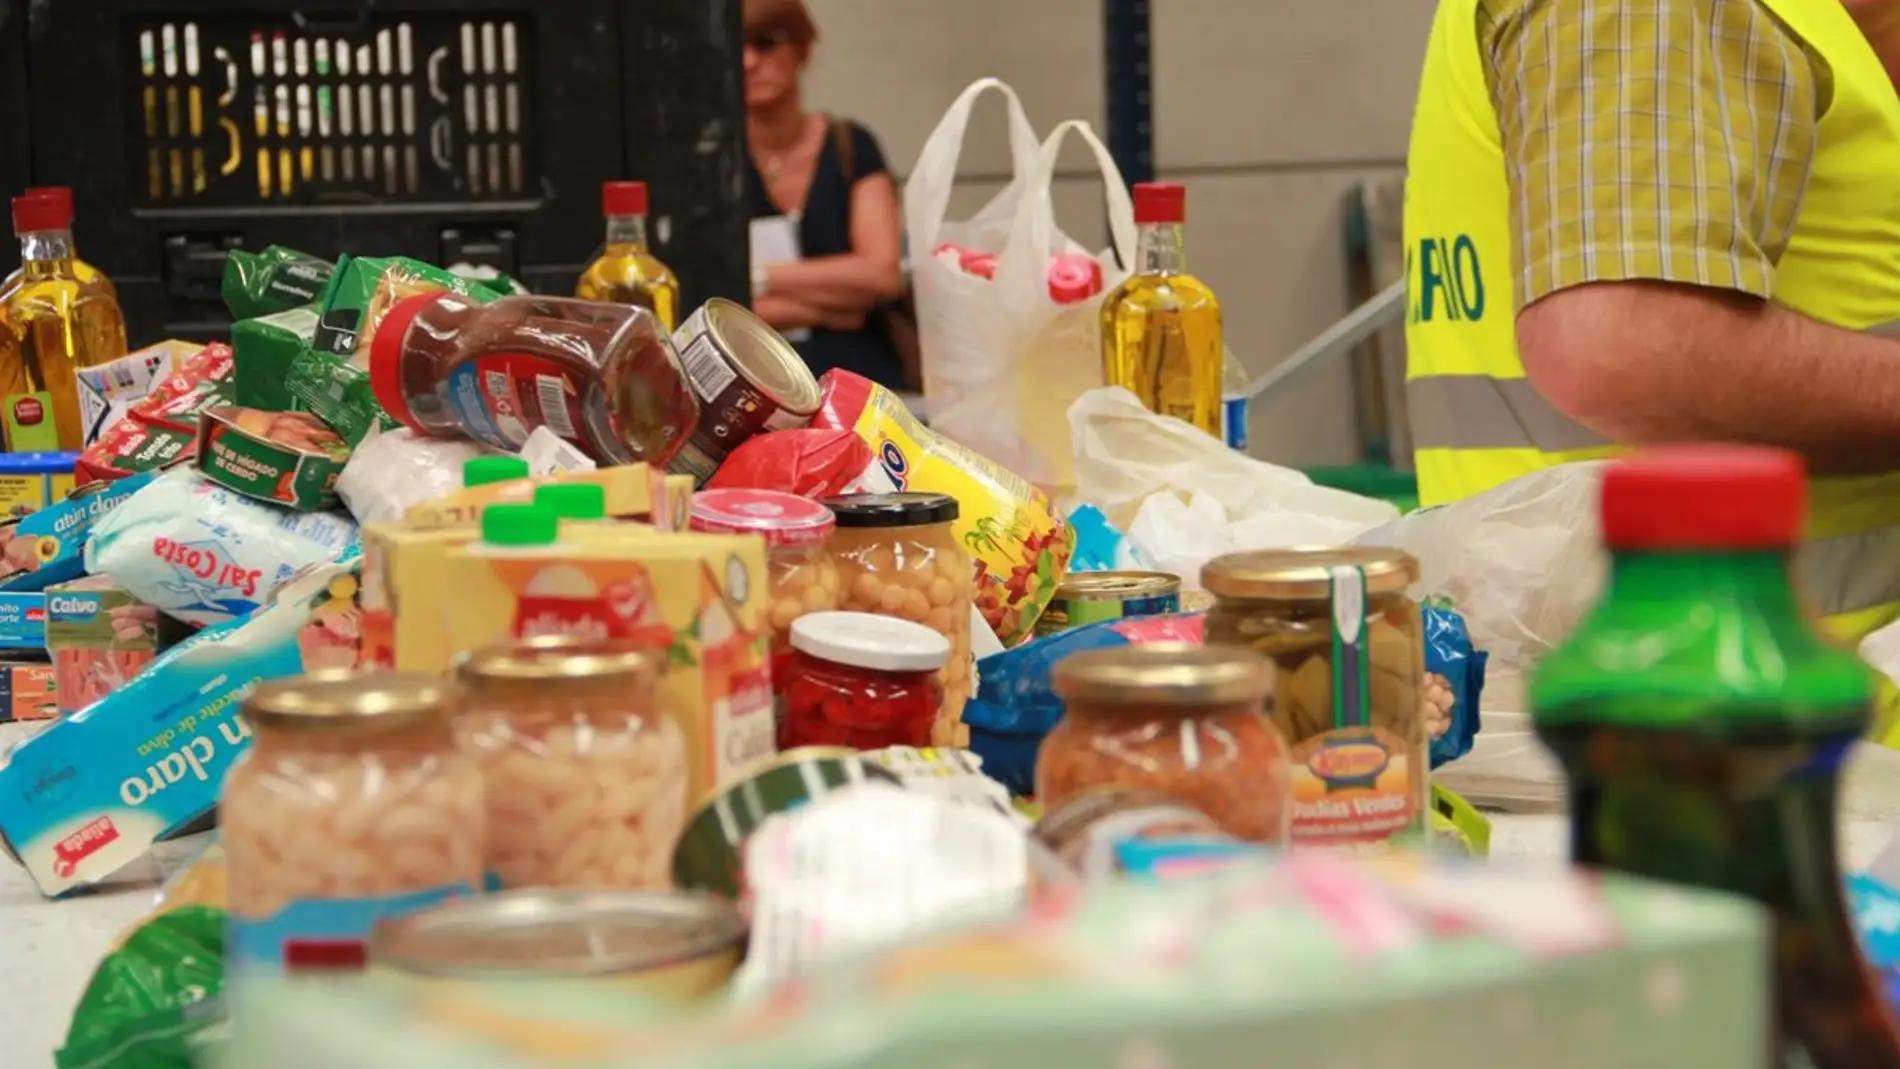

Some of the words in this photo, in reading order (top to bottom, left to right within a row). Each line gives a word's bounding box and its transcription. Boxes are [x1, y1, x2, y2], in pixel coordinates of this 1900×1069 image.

[1407, 234, 1485, 323] RIO
[153, 537, 217, 579] Costa
[219, 563, 263, 597] Sal
[50, 597, 98, 614] Calvo
[120, 736, 215, 806] claro
